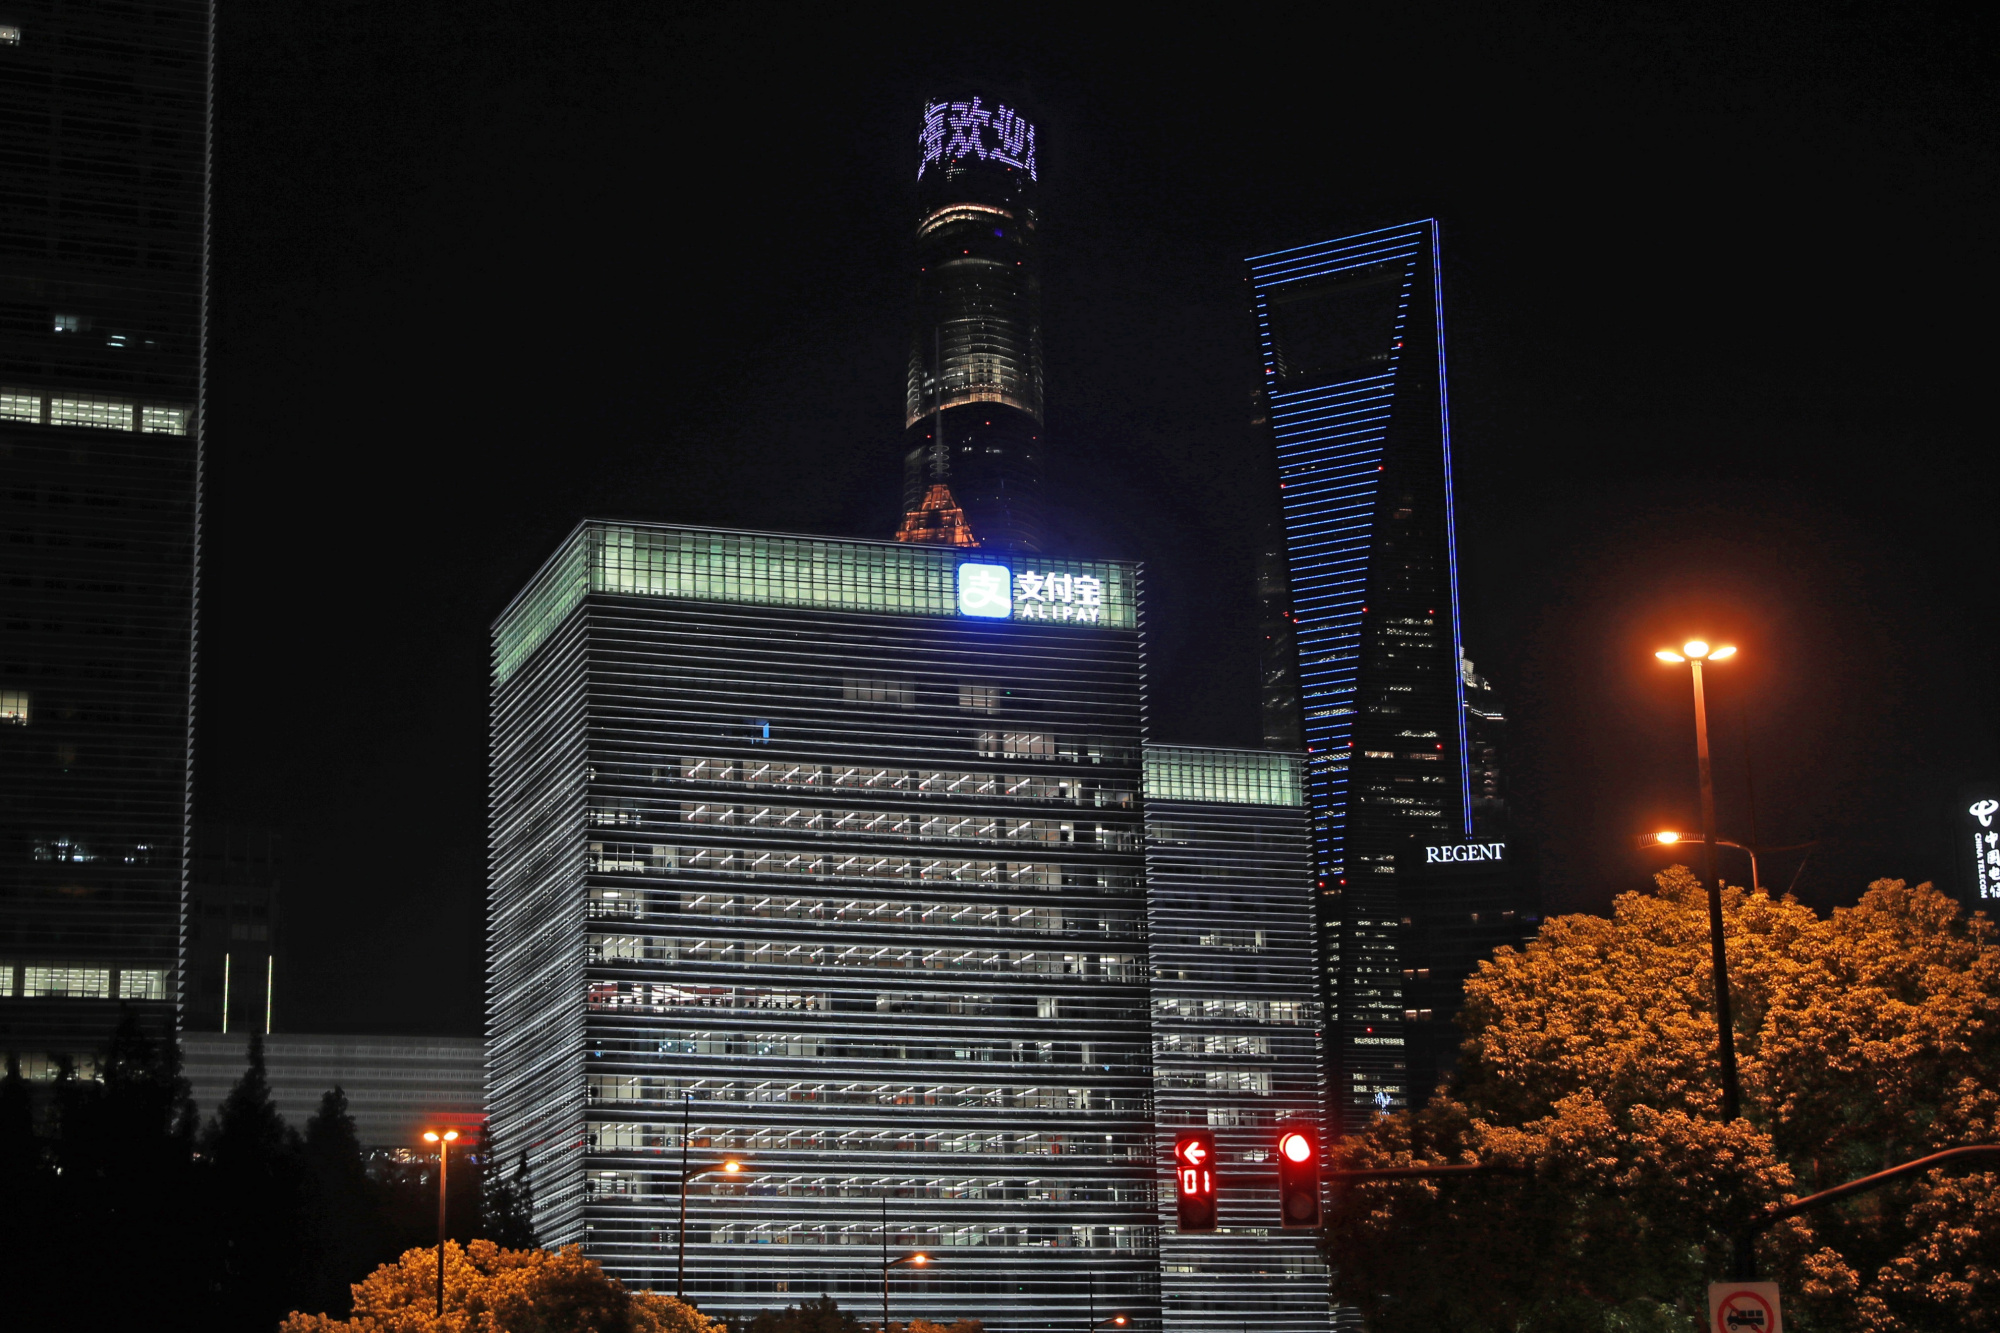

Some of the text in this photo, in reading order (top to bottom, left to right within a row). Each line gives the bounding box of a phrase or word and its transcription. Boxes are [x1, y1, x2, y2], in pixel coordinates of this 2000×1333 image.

[1016, 571, 1101, 605] 支付宝
[1022, 603, 1099, 622] ALIPAY
[1425, 843, 1505, 863] REGENT
[1974, 832, 1988, 899] CHINA TELECOM
[1183, 1169, 1210, 1194] 01
